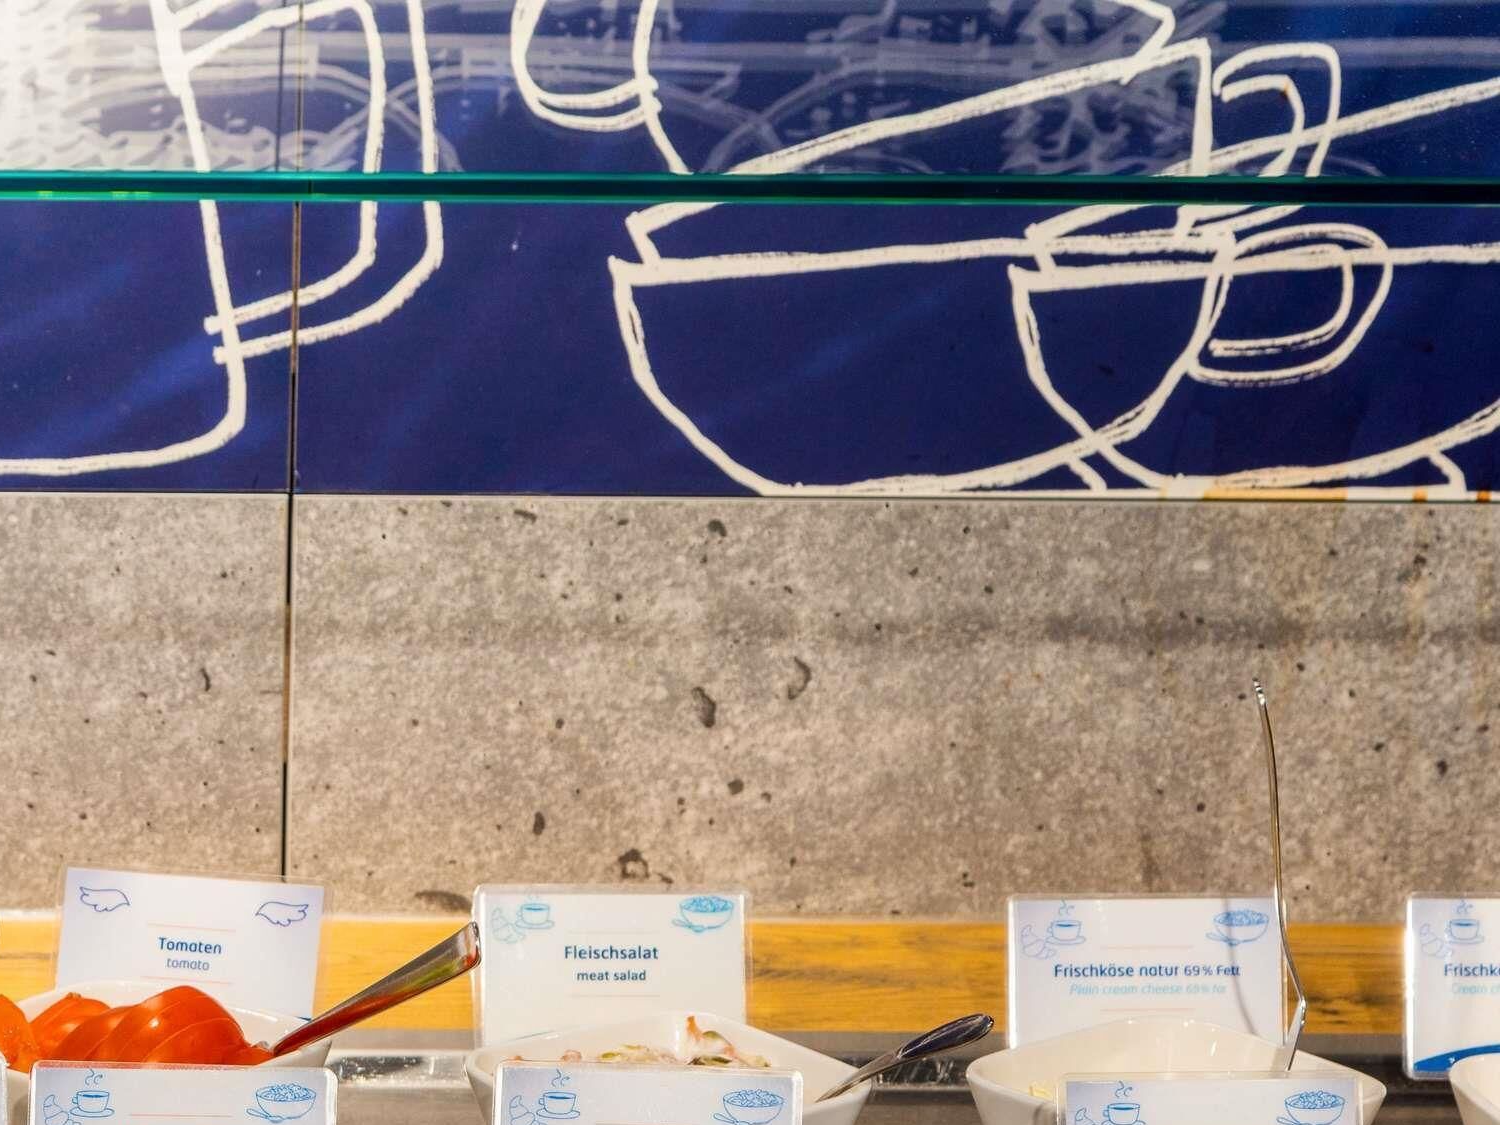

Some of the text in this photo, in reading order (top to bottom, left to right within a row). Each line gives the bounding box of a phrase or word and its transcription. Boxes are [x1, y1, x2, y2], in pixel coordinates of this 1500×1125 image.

[158, 936, 222, 954] Tomaten
[564, 944, 658, 960] Fleischsalat
[166, 958, 210, 971] tomato
[1053, 963, 1134, 978] Frischkäse
[1139, 965, 1179, 977] natur
[1217, 965, 1241, 977] Fett
[577, 969, 646, 981] meat salad
